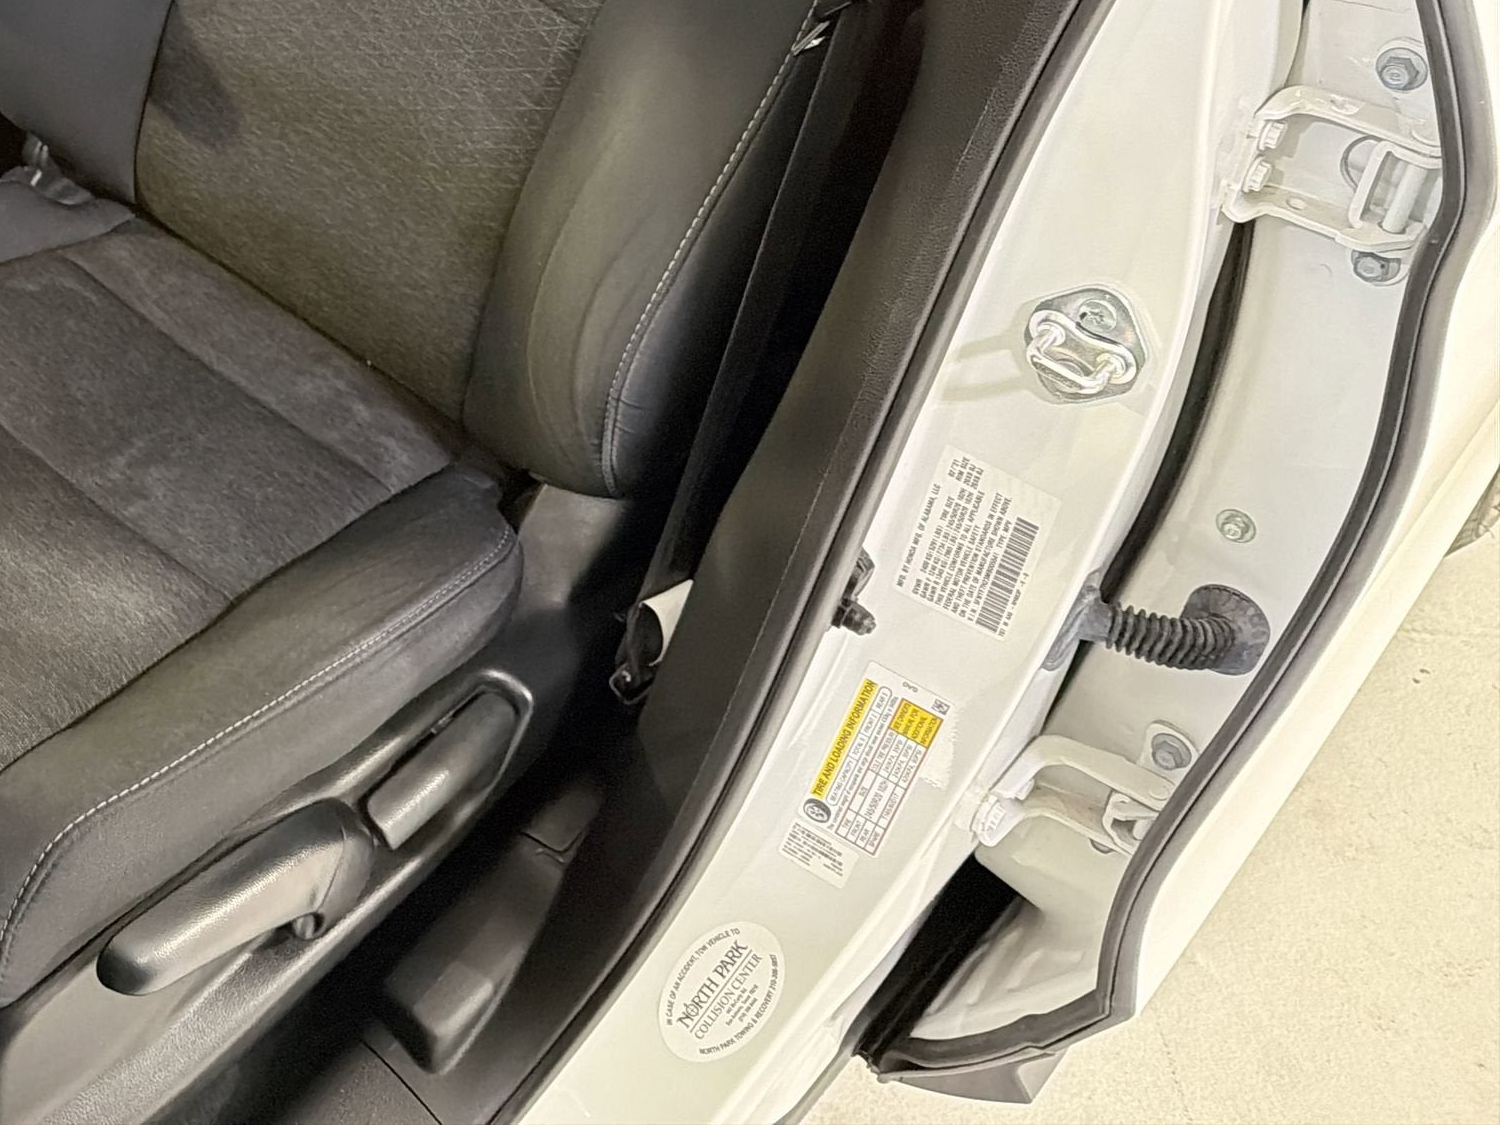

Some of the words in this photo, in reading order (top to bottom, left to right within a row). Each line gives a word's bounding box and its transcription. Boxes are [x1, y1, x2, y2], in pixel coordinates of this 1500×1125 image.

[959, 456, 970, 470] SIZE
[955, 469, 964, 482] RIM
[931, 482, 941, 495] LLC
[944, 495, 955, 509] SIZE
[967, 490, 985, 523] APPLICABLE
[999, 495, 1012, 516] ABOVE.
[939, 508, 950, 522] TIRE
[917, 522, 926, 532] OF
[962, 522, 972, 534] ALL
[991, 515, 1004, 536] SHOWN
[1002, 519, 1013, 533] MPV
[912, 531, 923, 545] MFG.
[959, 533, 968, 542] TO
[905, 545, 917, 565] HONDA
[948, 542, 964, 571] CONFORMS
[951, 601, 960, 614] AND
[956, 585, 966, 601] THEFT
[962, 552, 979, 585] PREVENTION
[975, 520, 992, 552] STANDARDS
[990, 492, 1003, 513] EFFECT
[975, 537, 995, 576] MANUFACTURE
[901, 564, 910, 573] BY
[943, 587, 956, 610] FEDERAL
[952, 567, 964, 586] MOTOR
[959, 545, 972, 567] VEHICLE
[968, 524, 981, 545] SAFETY
[895, 572, 907, 588] MFG.
[911, 578, 923, 595] GVWR
[940, 572, 952, 593] VEHICLE
[971, 576, 980, 584] OF
[919, 582, 930, 598] GAWR
[927, 586, 938, 602] GAWR
[966, 583, 977, 598] DATE
[935, 593, 944, 606] THIS
[962, 598, 971, 609] THE
[958, 608, 967, 618] ON
[813, 778, 827, 796] TIRE
[821, 762, 835, 779] AND
[830, 728, 852, 763] LOADING
[846, 680, 876, 730] INFORMATION
[829, 781, 843, 802] SEATING
[839, 760, 854, 782] CAPACITY
[852, 741, 863, 756] TOTAL
[864, 717, 875, 733] FRONT
[875, 695, 886, 709] REAR
[842, 818, 851, 829] TIRE
[850, 820, 862, 836] FRONT
[859, 828, 870, 842] REAR
[869, 831, 880, 847] SPARE
[707, 930, 731, 947] VEHICLE
[730, 928, 741, 936] TO
[695, 946, 709, 957] TOW
[677, 955, 699, 983] ACCIDENT,
[674, 981, 681, 991] AN
[676, 977, 721, 1029] NORTH
[712, 940, 749, 980] PARK
[671, 990, 677, 1000] OF
[694, 988, 737, 1039] COLLISION
[731, 953, 763, 991] CENTER
[667, 1000, 675, 1017] CASE
[699, 1046, 721, 1055] NORTH
[720, 1038, 736, 1050] PARK
[734, 1021, 755, 1041] TOWING
[755, 989, 774, 1019] RECOVERY
